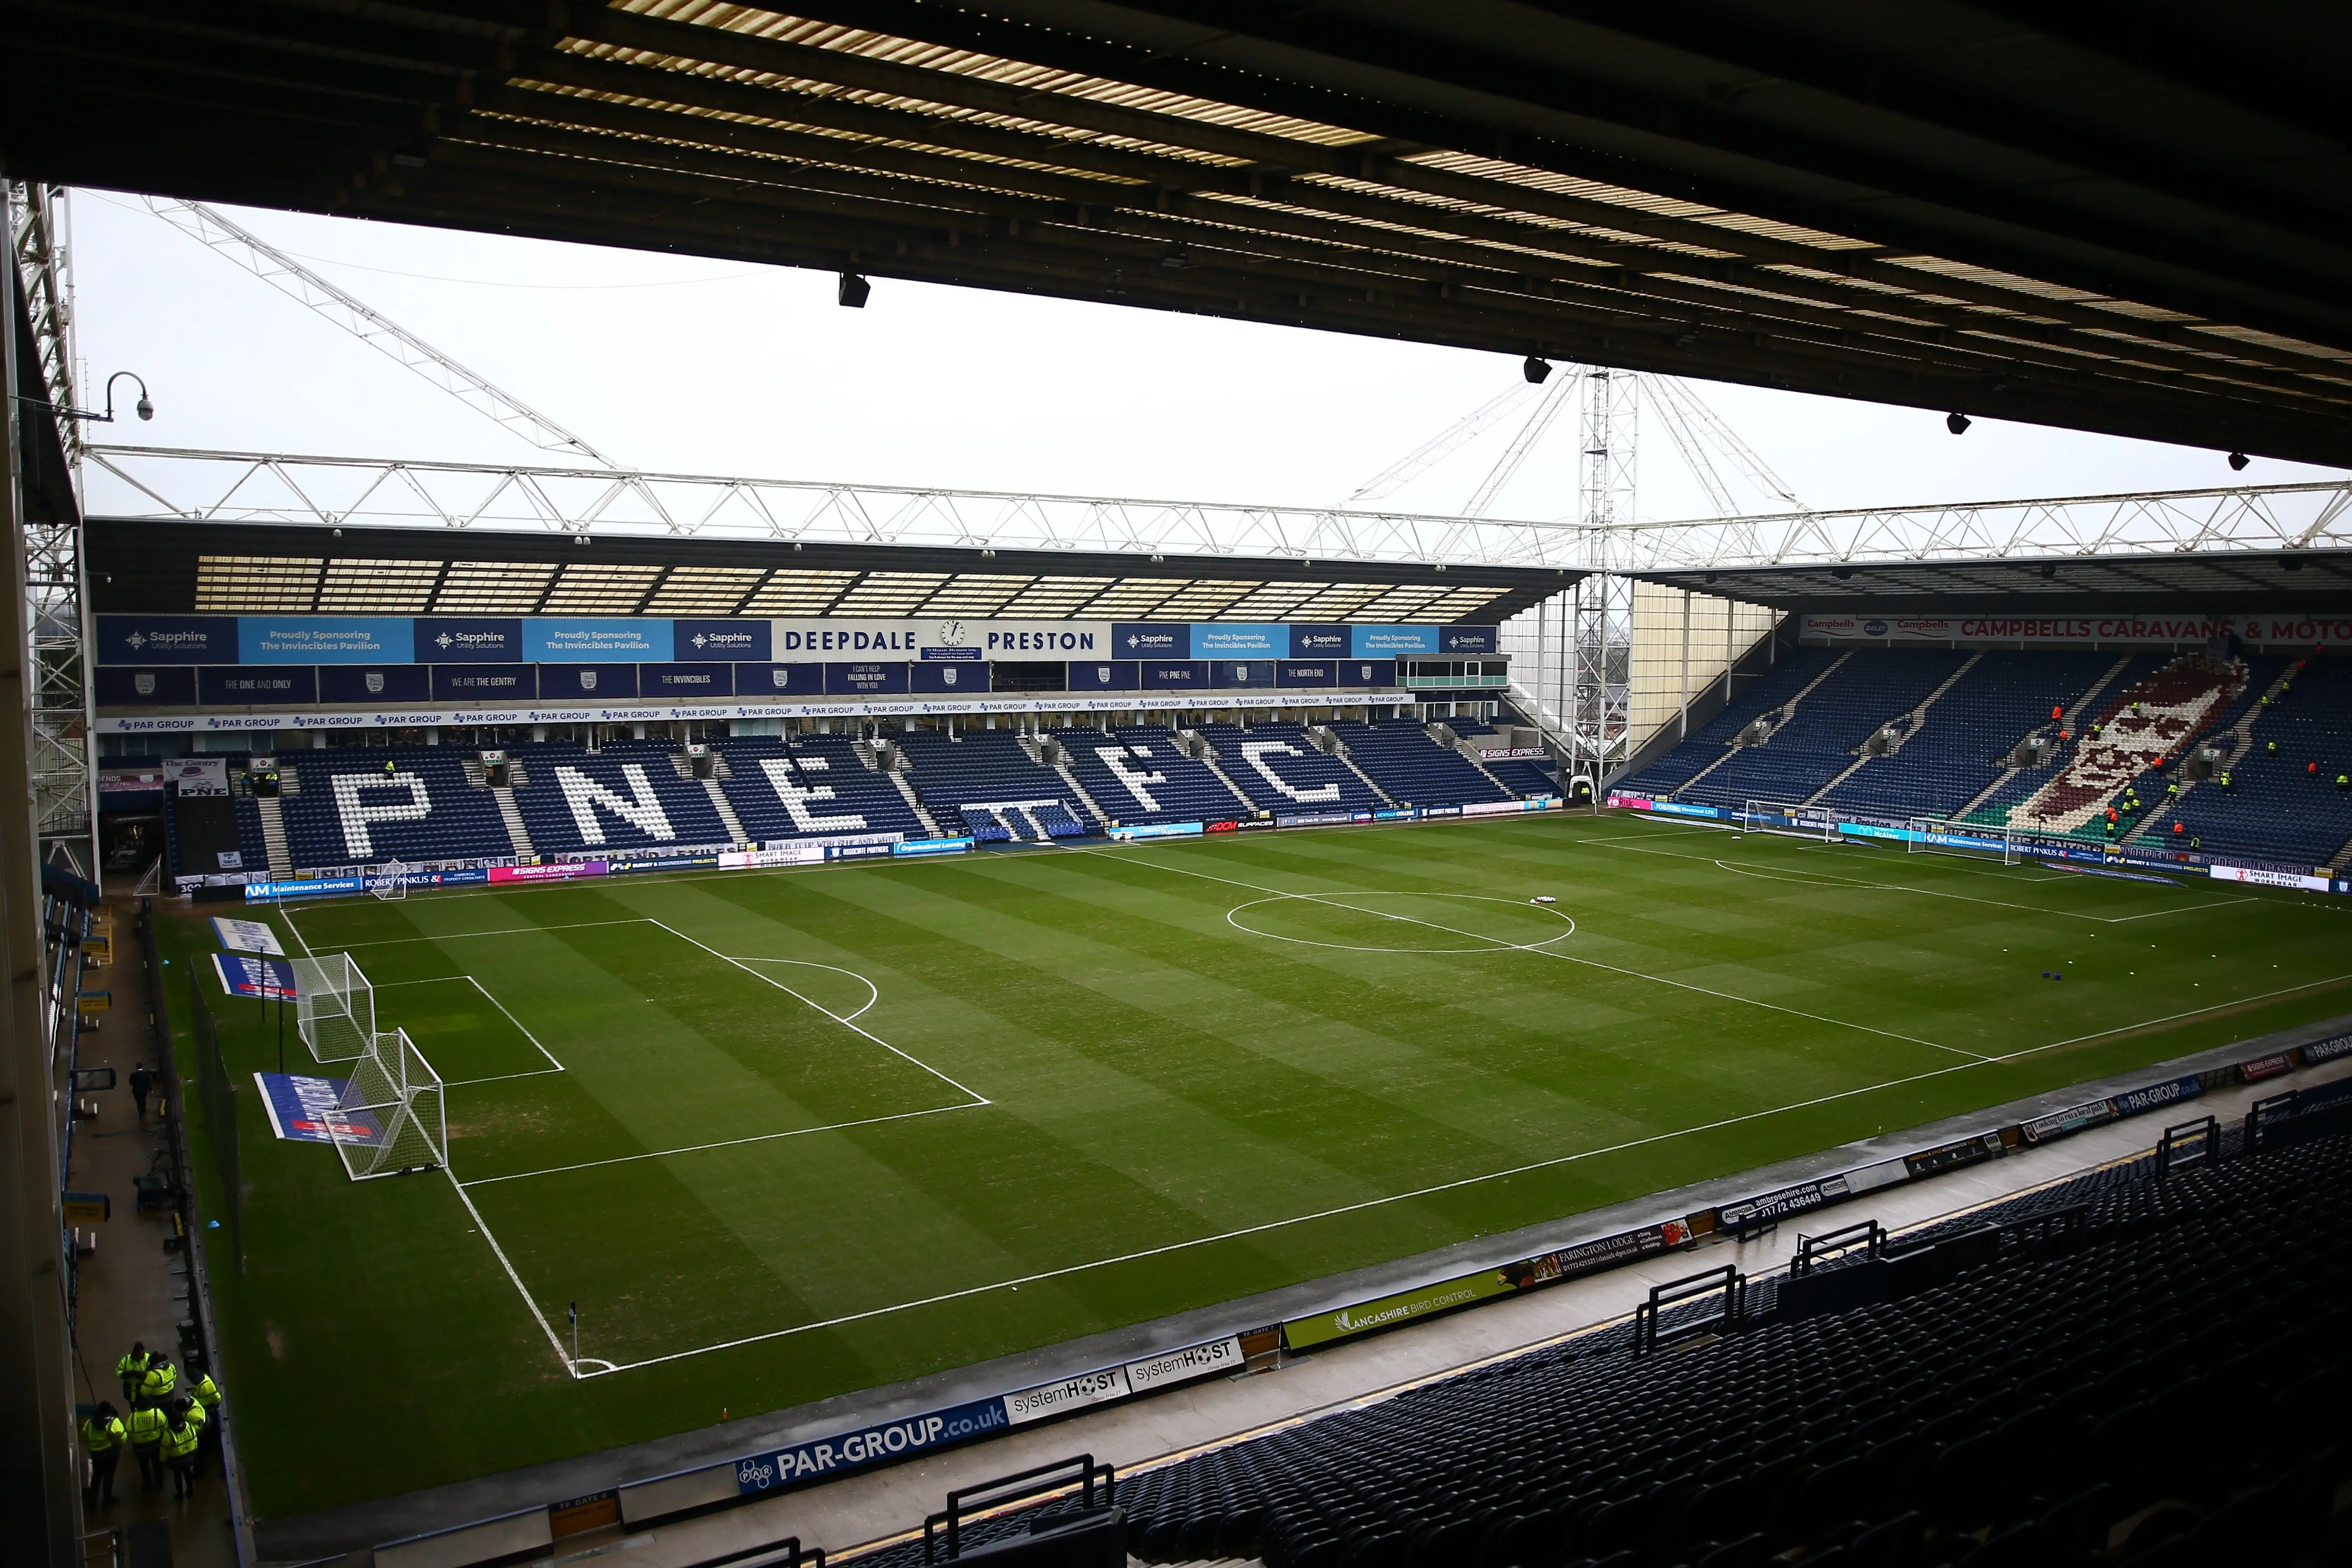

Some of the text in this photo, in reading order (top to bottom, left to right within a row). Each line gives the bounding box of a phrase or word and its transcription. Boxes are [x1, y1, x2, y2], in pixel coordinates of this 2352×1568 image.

[1808, 620, 1854, 629] Campbells
[1897, 620, 1949, 631] Campbells
[1961, 621, 2091, 638] CAMPBELLS
[2098, 621, 2234, 639] CARAVANS
[2244, 621, 2262, 639] &
[150, 631, 207, 643] Sapphire
[270, 631, 371, 641] Proudly Sponsoring
[456, 633, 505, 642] Sapphire
[555, 631, 641, 640] Proudly Sponsoring
[709, 633, 752, 643] Sapphire
[282, 641, 337, 650] Invincibles
[340, 641, 380, 649] Pavilion
[786, 632, 915, 650] DEEPDALE
[988, 632, 1094, 650] PRESTON
[225, 679, 291, 689] THE ONE AND ONLY
[476, 678, 489, 686] THE
[491, 677, 516, 686] GENTRY
[674, 675, 710, 684] INVINCIBLES
[134, 720, 194, 729] PAR GROUP
[244, 718, 280, 727] GROUP
[307, 717, 362, 725] PAR GROUP
[1487, 747, 1544, 758] SIGNS EXPRESS
[1216, 821, 1238, 831] DCM
[1874, 831, 1900, 840] McAteer
[1949, 838, 1981, 846] Maintenance
[843, 846, 888, 855] ASSOCIATE PARTNERS
[901, 843, 941, 852] Organisational
[2010, 844, 2031, 853] ROBERT
[2033, 847, 2057, 857] PINKUS
[520, 864, 585, 875] SIGNS EXPRESS
[365, 874, 429, 887] ROBERT PINKUS
[2249, 870, 2302, 883] SMART IMAGE
[2255, 878, 2297, 887] WORKWEAR
[273, 884, 322, 893] Maintenance
[2265, 1057, 2284, 1067] EXPRESS
[2128, 1079, 2201, 1109] PAR-GROUP.co.uk
[1755, 1184, 1817, 1207] ambrosehire.com
[1790, 1192, 1821, 1209] 436449
[1559, 1234, 1635, 1262] FARINGTON LODGE
[1563, 1263, 1579, 1271] 01772
[1579, 1258, 1596, 1267] 421321
[1348, 1288, 1476, 1330] LANCASHIRE BIRD CONTROL
[777, 1405, 1005, 1480] PAR-GROUP.co.uk
[575, 1495, 599, 1506] GATE
